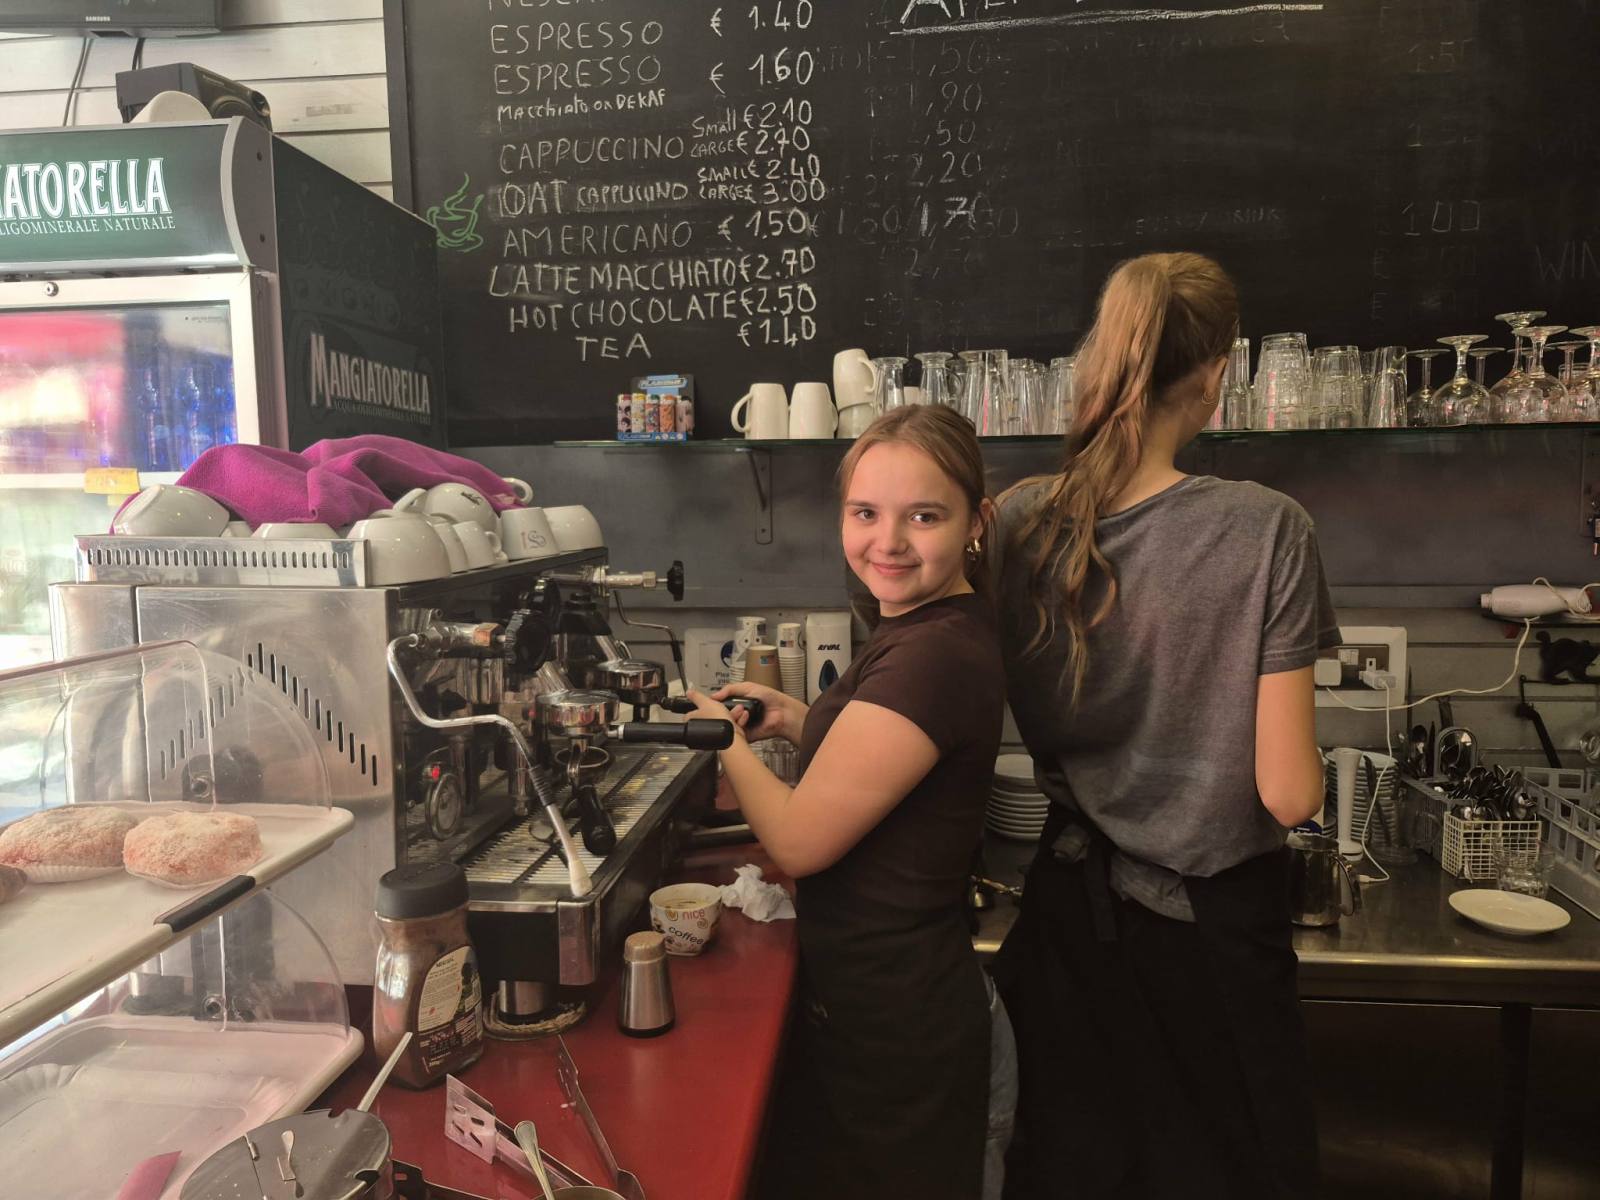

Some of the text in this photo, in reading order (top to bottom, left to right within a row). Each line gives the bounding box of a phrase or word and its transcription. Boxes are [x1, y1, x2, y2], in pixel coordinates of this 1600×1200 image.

[491, 21, 663, 54] ESPRESSO
[494, 56, 661, 94] ESPRESSO
[748, 47, 813, 85] 1.60
[616, 89, 665, 110] DEKAF
[500, 135, 684, 174] CAPPUCCINO
[691, 140, 734, 157] LARGE
[501, 179, 568, 217] OAT
[104, 216, 176, 232] NATURALE
[503, 221, 692, 257] AMERICANO
[489, 262, 581, 297] LATTE
[590, 254, 736, 291] MACCHIATO
[509, 303, 563, 333] HOT
[571, 289, 737, 329] CHOCOLATE
[575, 332, 651, 361] TEA
[682, 908, 705, 921] nice
[669, 926, 704, 945] coffee
